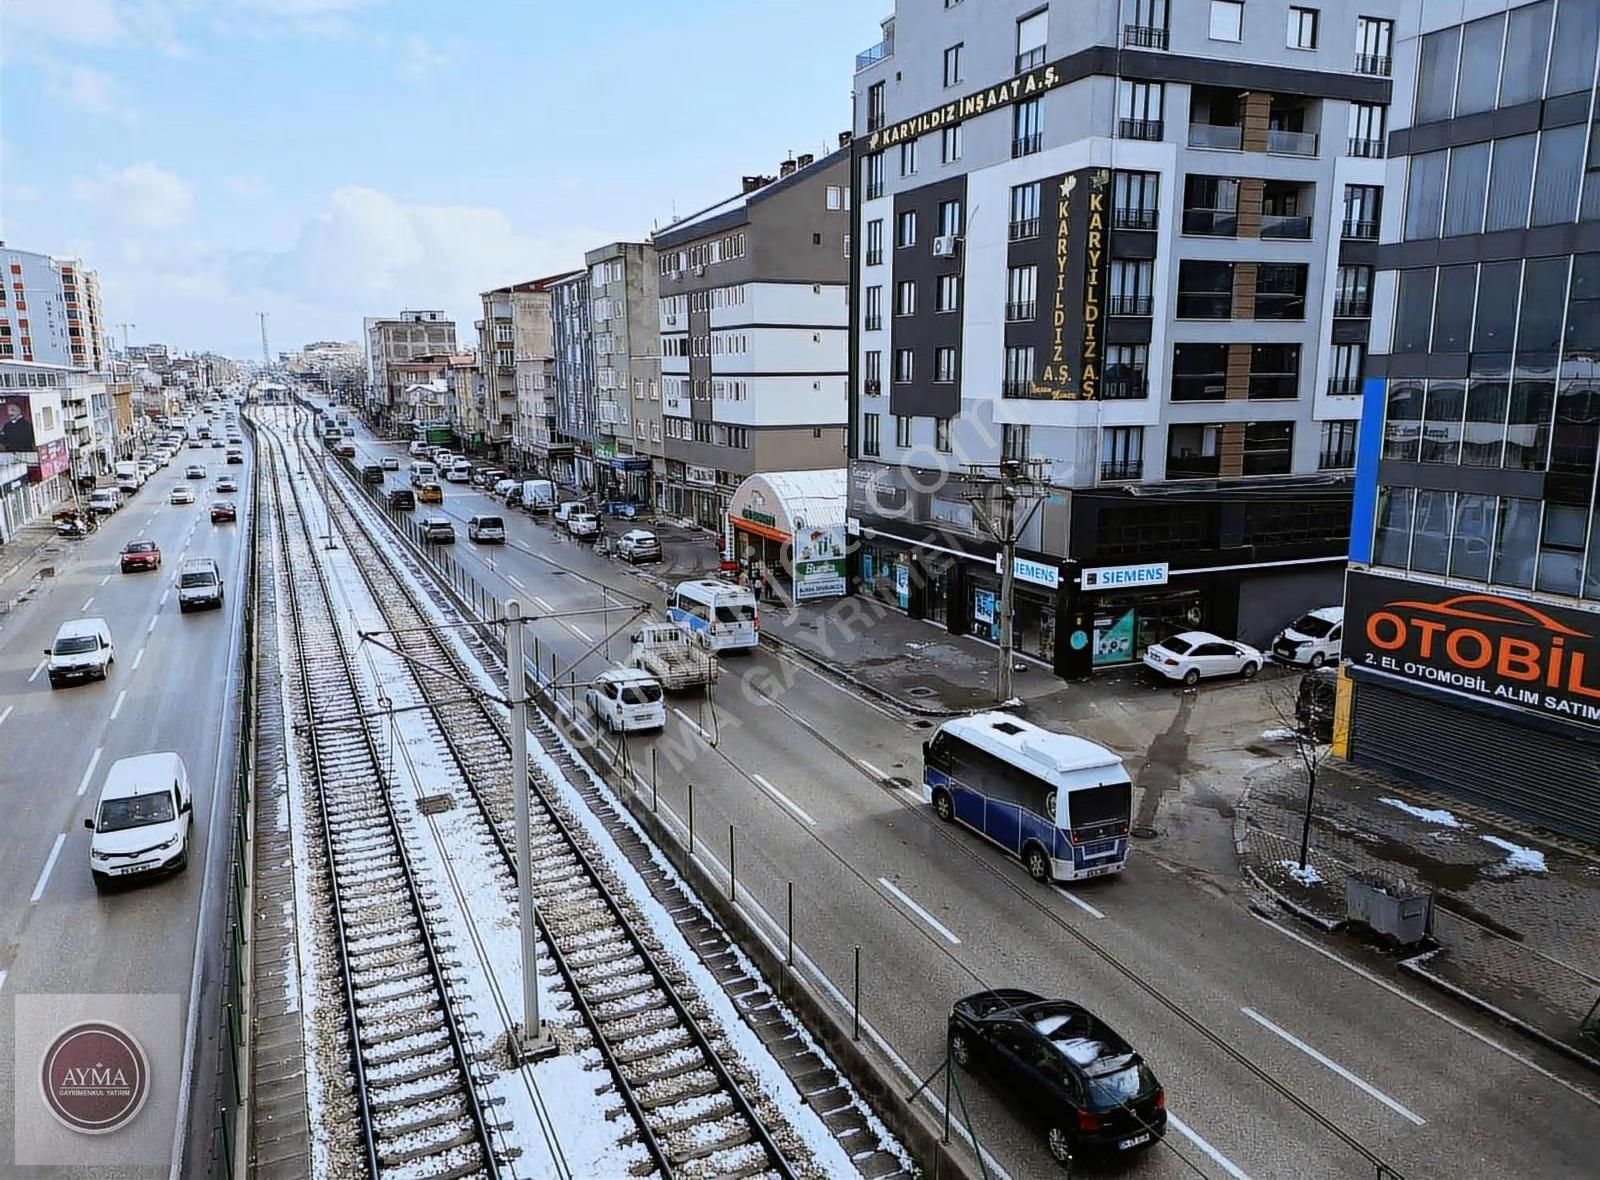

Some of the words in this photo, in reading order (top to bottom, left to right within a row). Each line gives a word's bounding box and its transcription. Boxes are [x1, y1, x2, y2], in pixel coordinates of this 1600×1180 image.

[882, 103, 955, 147] KARYILDIZ
[959, 80, 1021, 117] İNŞAAT
[1024, 66, 1060, 94] A.Ş.
[1052, 200, 1070, 362] KARYILDIZ
[1084, 193, 1104, 358] KARYILDIZ
[1043, 364, 1073, 385] A.Ş.
[1015, 561, 1056, 584] IEMENS
[1102, 567, 1164, 585] SIEMENS
[1364, 652, 1377, 665] 2.
[1381, 656, 1400, 671] EL
[1404, 662, 1491, 693] OTOMOBİL
[1494, 684, 1539, 706] ALIM
[1544, 696, 1600, 721] SATIM
[1366, 611, 1600, 699] OTOBİL
